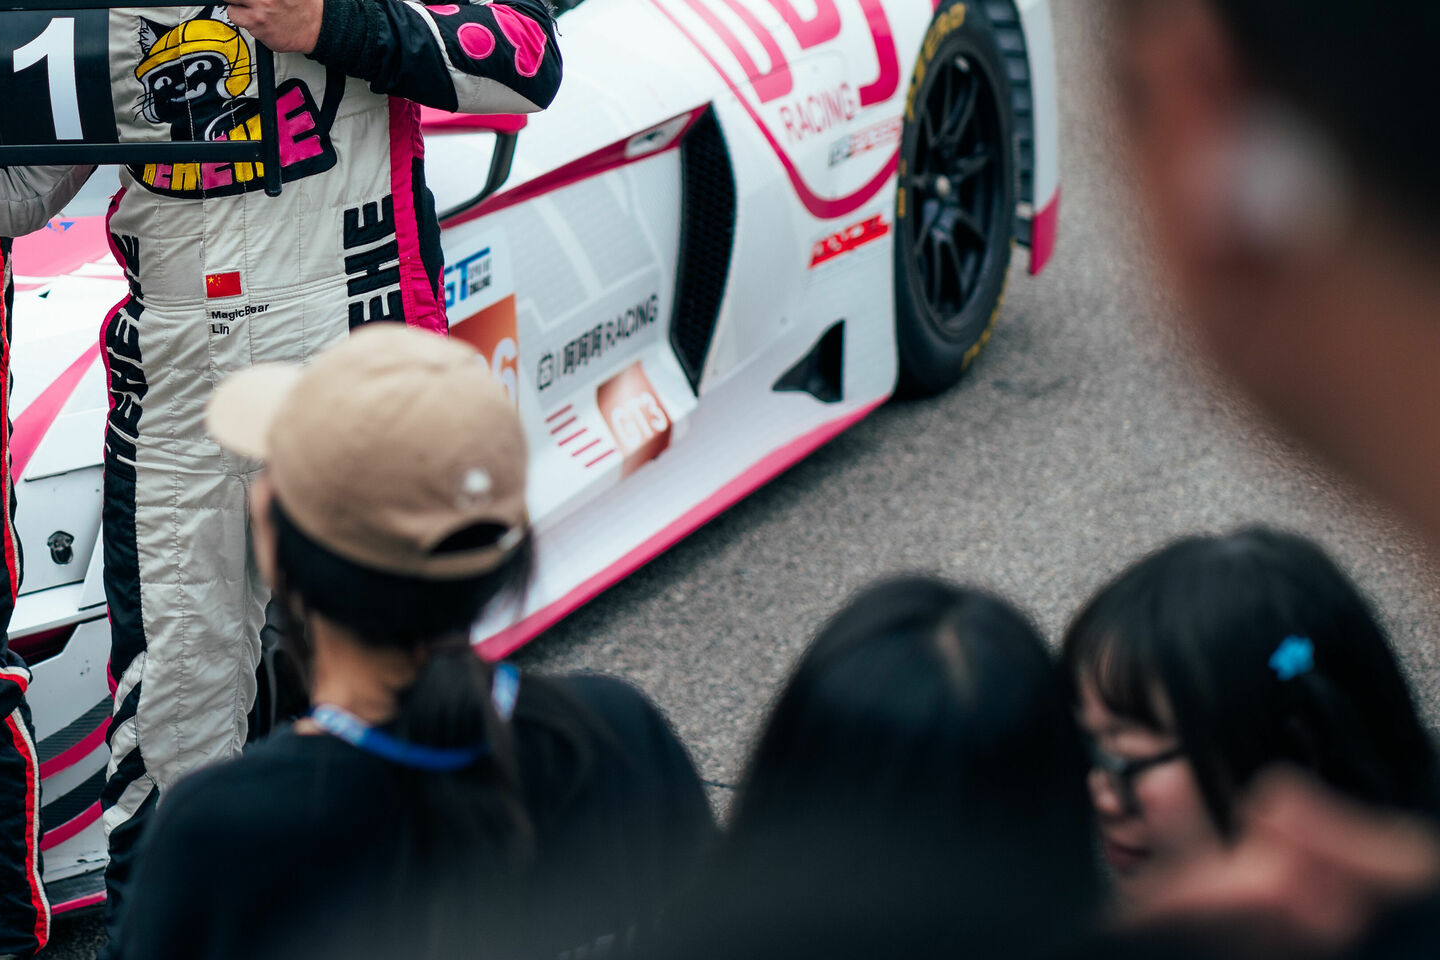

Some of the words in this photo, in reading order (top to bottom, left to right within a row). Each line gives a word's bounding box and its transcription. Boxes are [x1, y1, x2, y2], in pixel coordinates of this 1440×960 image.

[779, 82, 856, 142] RACING
[211, 304, 270, 321] MagicBear
[211, 323, 230, 335] Lin
[606, 293, 658, 347] RACING
[612, 392, 668, 448] GT3
